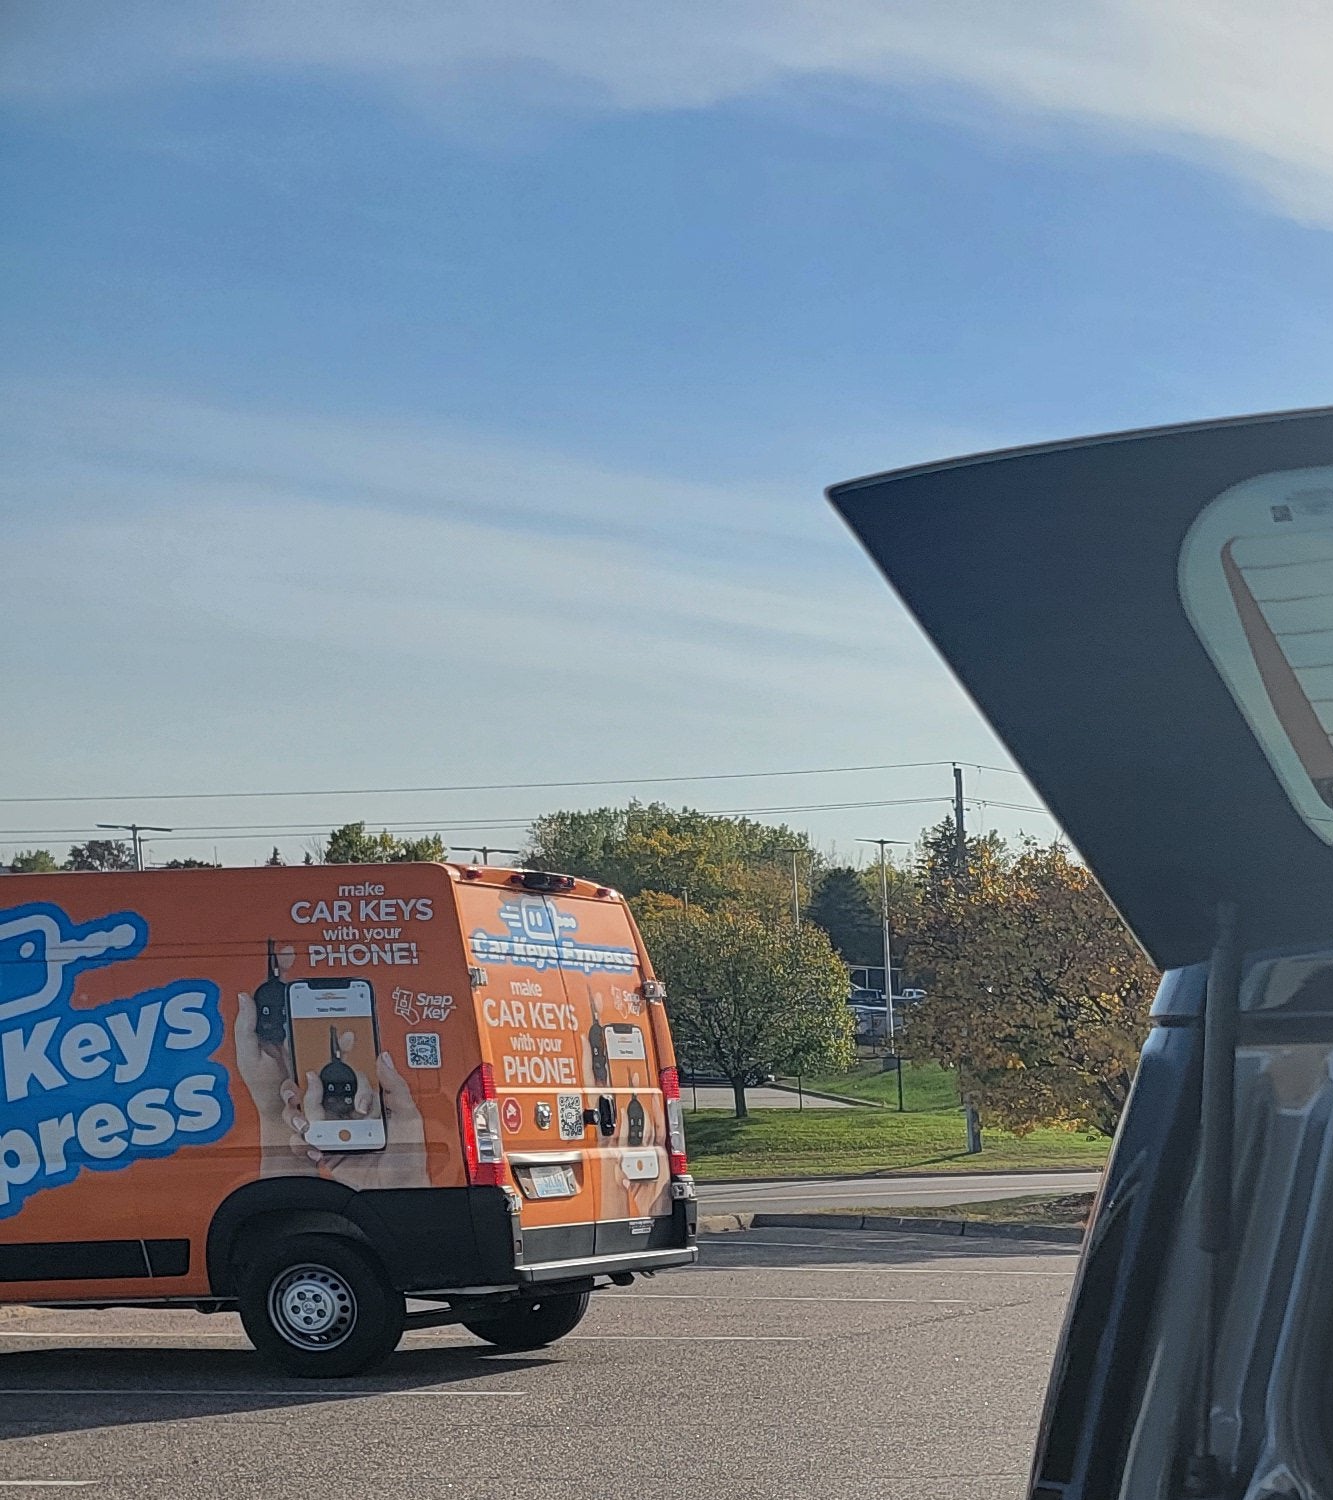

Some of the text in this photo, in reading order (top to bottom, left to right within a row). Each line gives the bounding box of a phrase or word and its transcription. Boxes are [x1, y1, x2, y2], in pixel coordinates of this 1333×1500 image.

[338, 882, 385, 897] make
[291, 898, 433, 923] CAR KEYS
[323, 926, 402, 942] with your
[308, 942, 419, 967] PHONE!
[473, 932, 509, 960] Car
[561, 941, 634, 972] Express
[415, 993, 453, 1006] Snap
[510, 979, 542, 997] make
[422, 1006, 450, 1022] Key
[483, 998, 578, 1031] CAR KEYS
[1, 992, 211, 1103] Keys
[510, 1033, 562, 1055] with your
[503, 1055, 576, 1085] PHONE!
